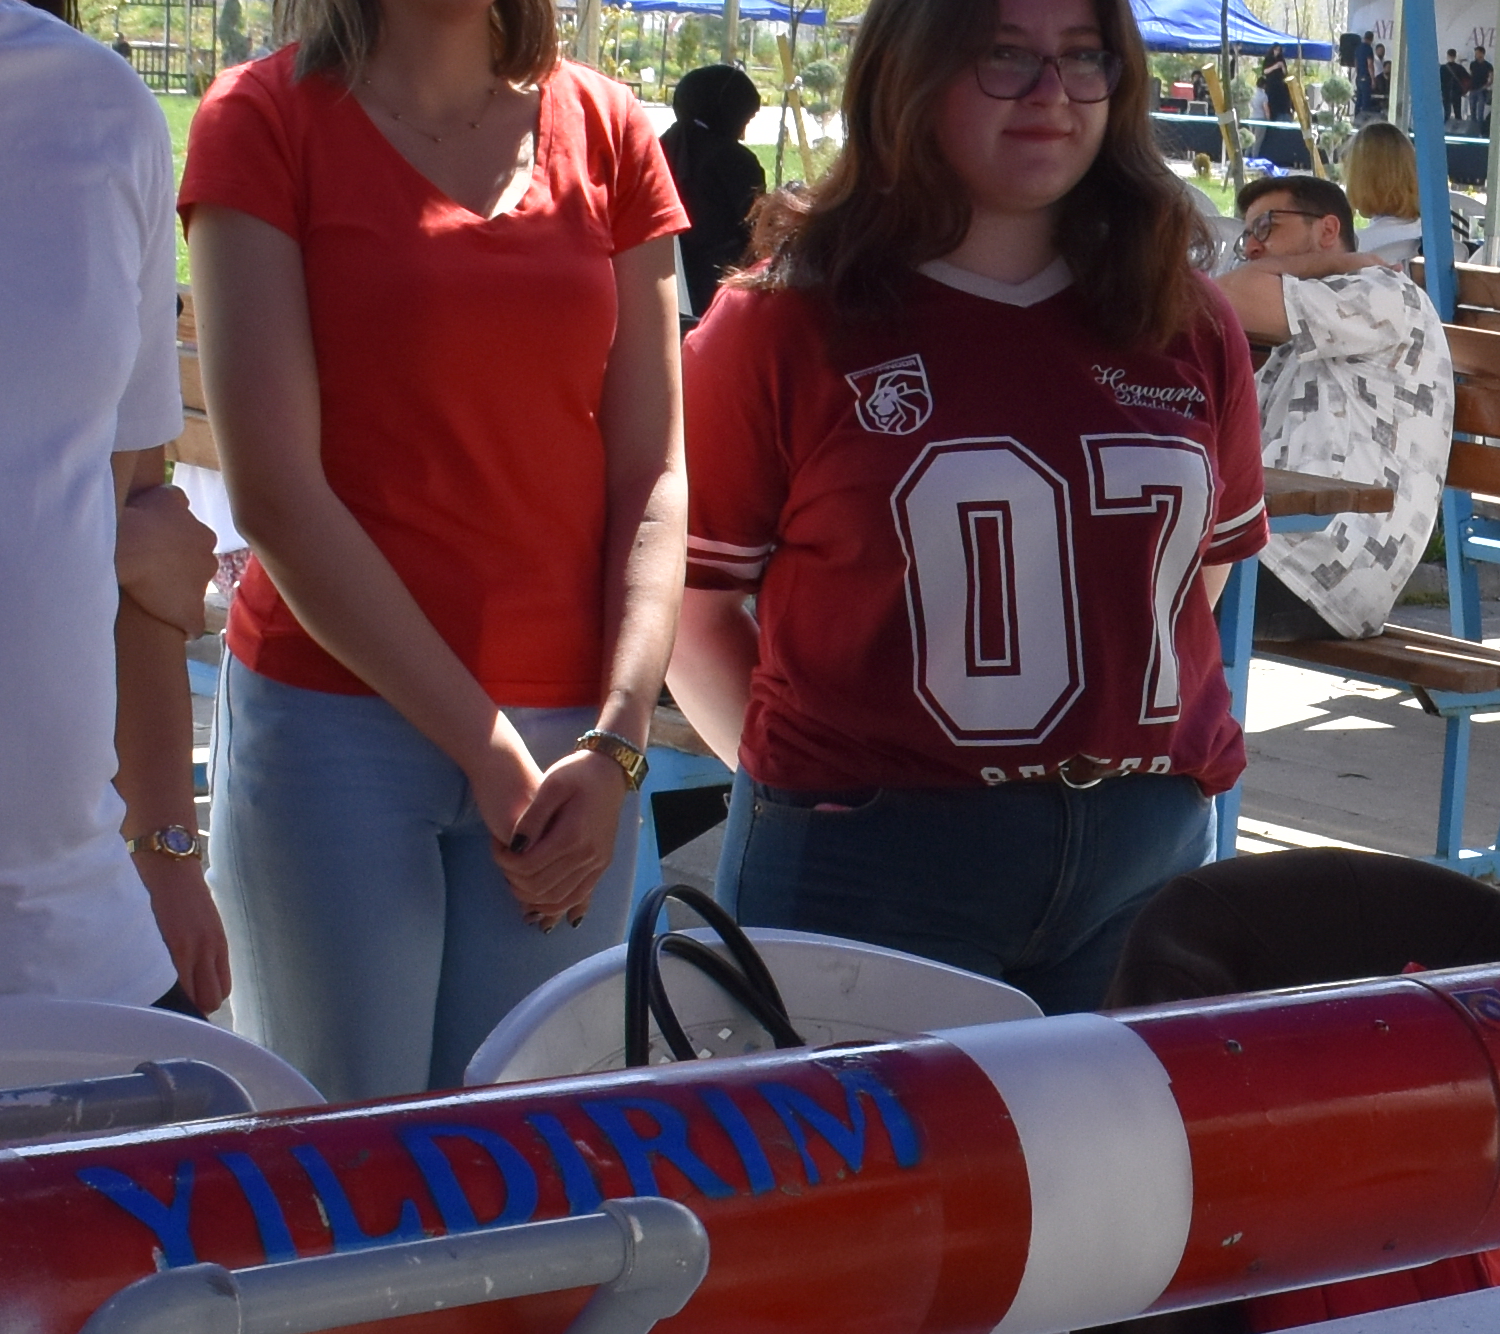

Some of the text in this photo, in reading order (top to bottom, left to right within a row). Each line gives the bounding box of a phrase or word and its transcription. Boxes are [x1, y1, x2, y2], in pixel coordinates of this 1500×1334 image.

[1091, 365, 1206, 403] Hogwarts
[890, 433, 1215, 747] 07
[76, 1065, 922, 1267] YILDIRIM
